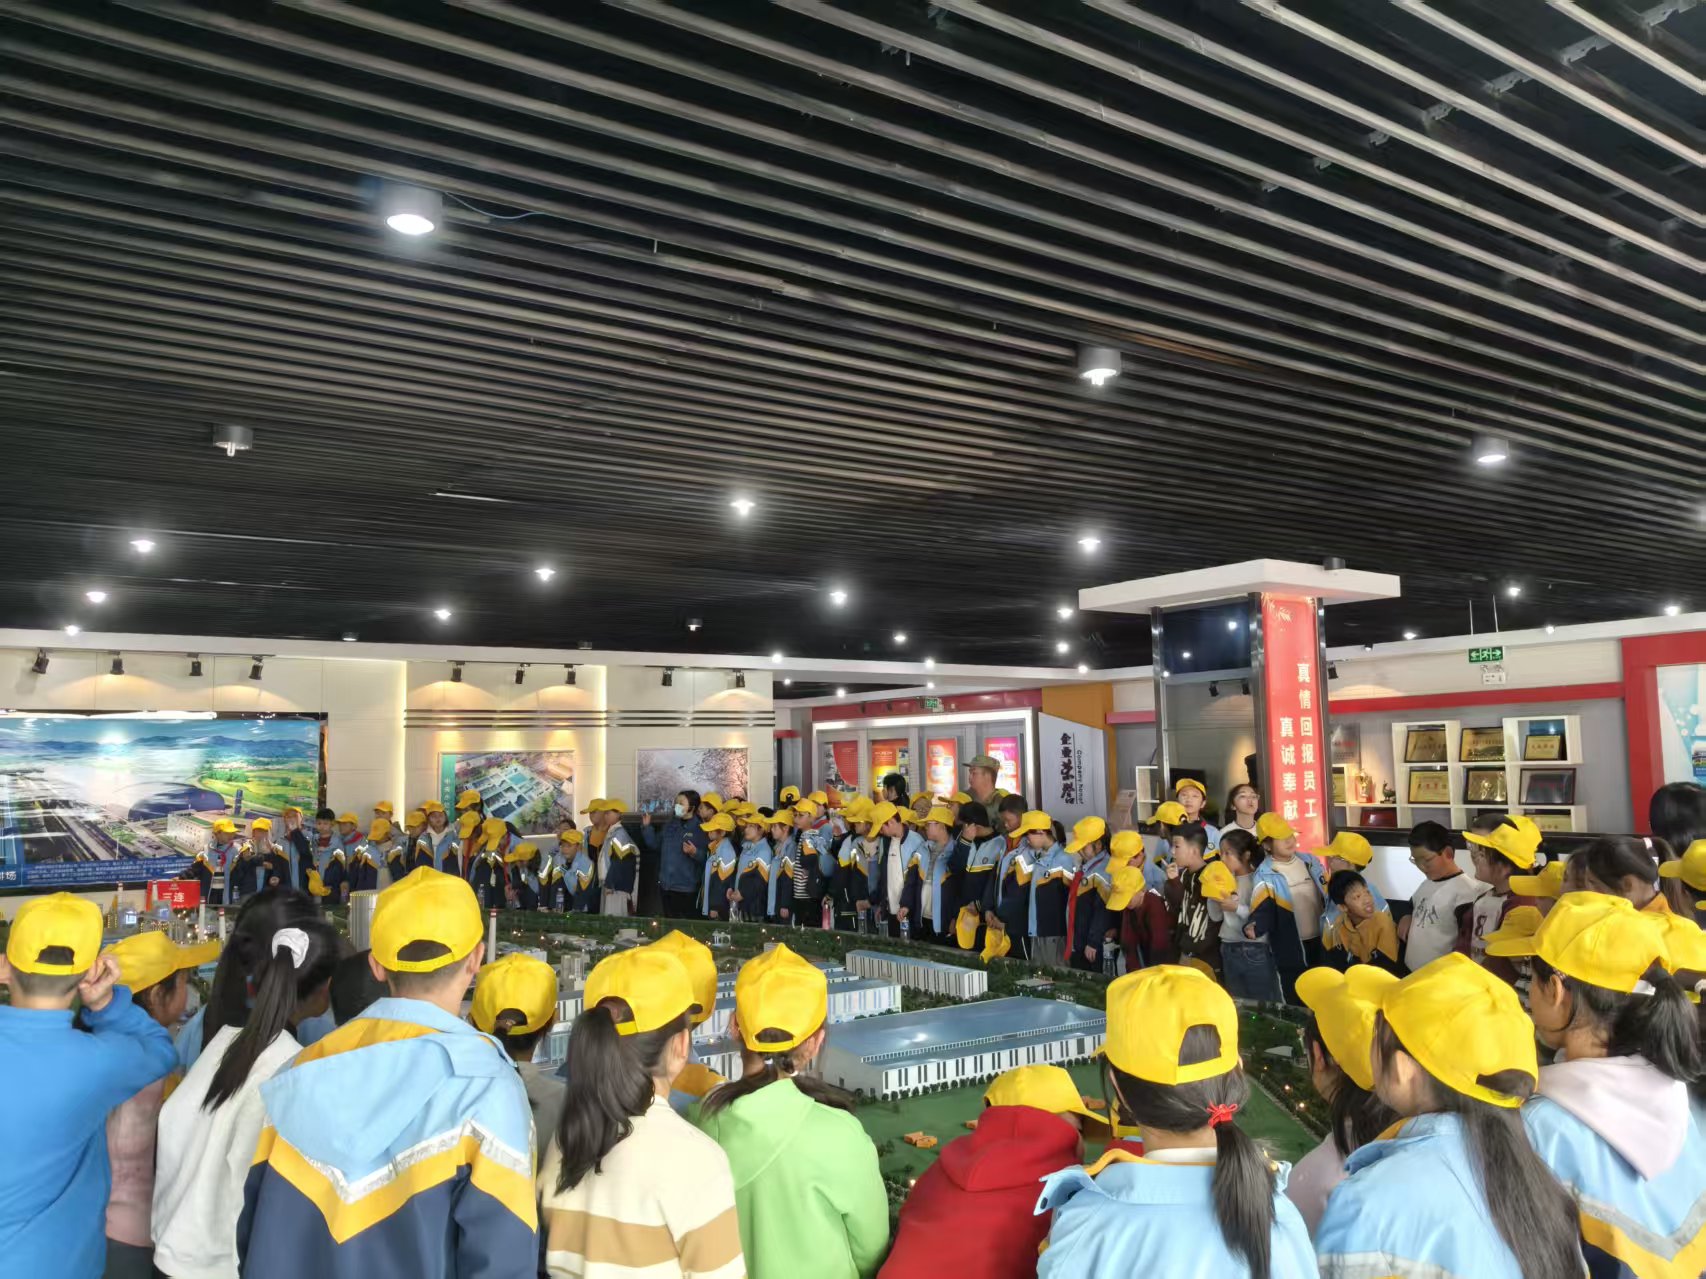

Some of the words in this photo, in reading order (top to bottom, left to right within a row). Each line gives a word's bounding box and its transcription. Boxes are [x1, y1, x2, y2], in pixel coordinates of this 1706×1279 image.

[1279, 716, 1300, 848] 真诚奉献
[1297, 662, 1317, 818] 真情回报员工
